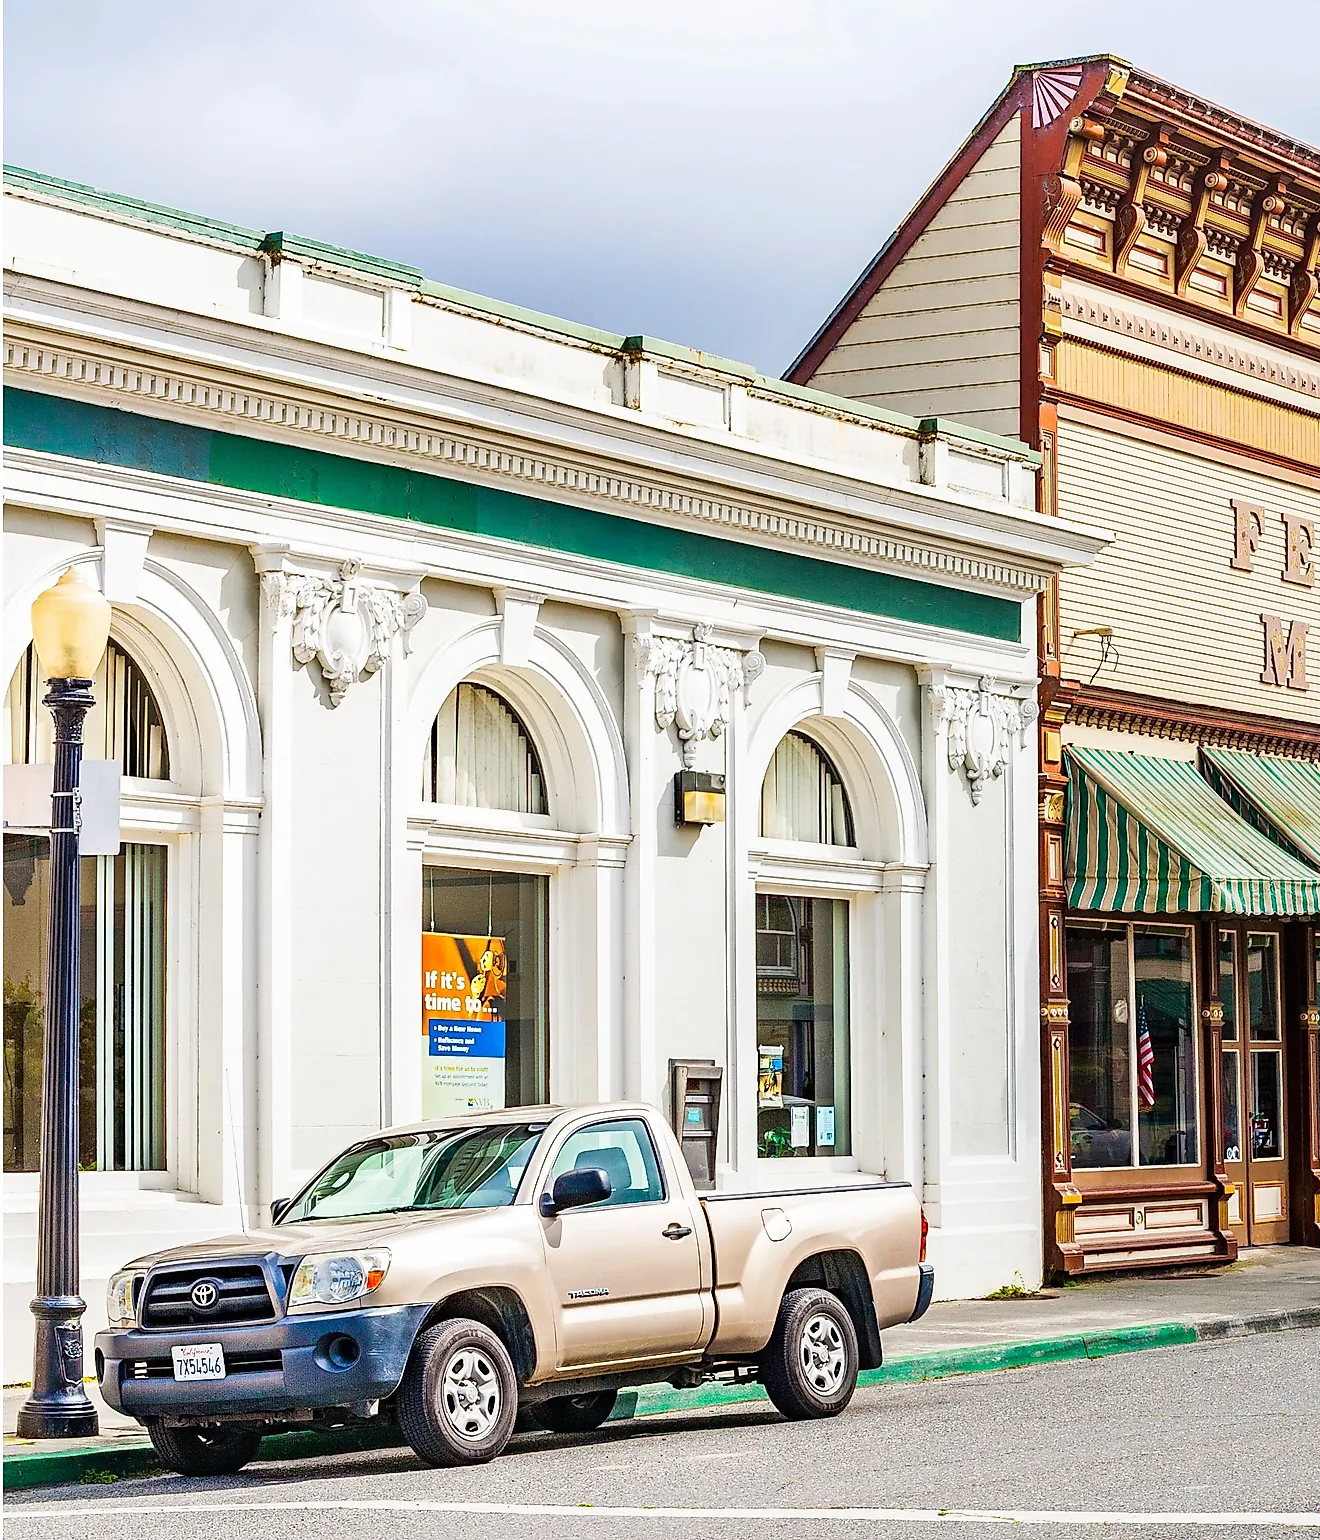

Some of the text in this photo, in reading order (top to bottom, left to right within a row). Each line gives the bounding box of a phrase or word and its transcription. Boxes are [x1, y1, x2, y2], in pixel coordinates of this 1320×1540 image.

[425, 971, 465, 990] If it's
[425, 993, 462, 1012] time
[568, 1287, 610, 1299] TACOMA
[182, 1347, 211, 1357] California
[176, 1356, 222, 1376] 7X54546
